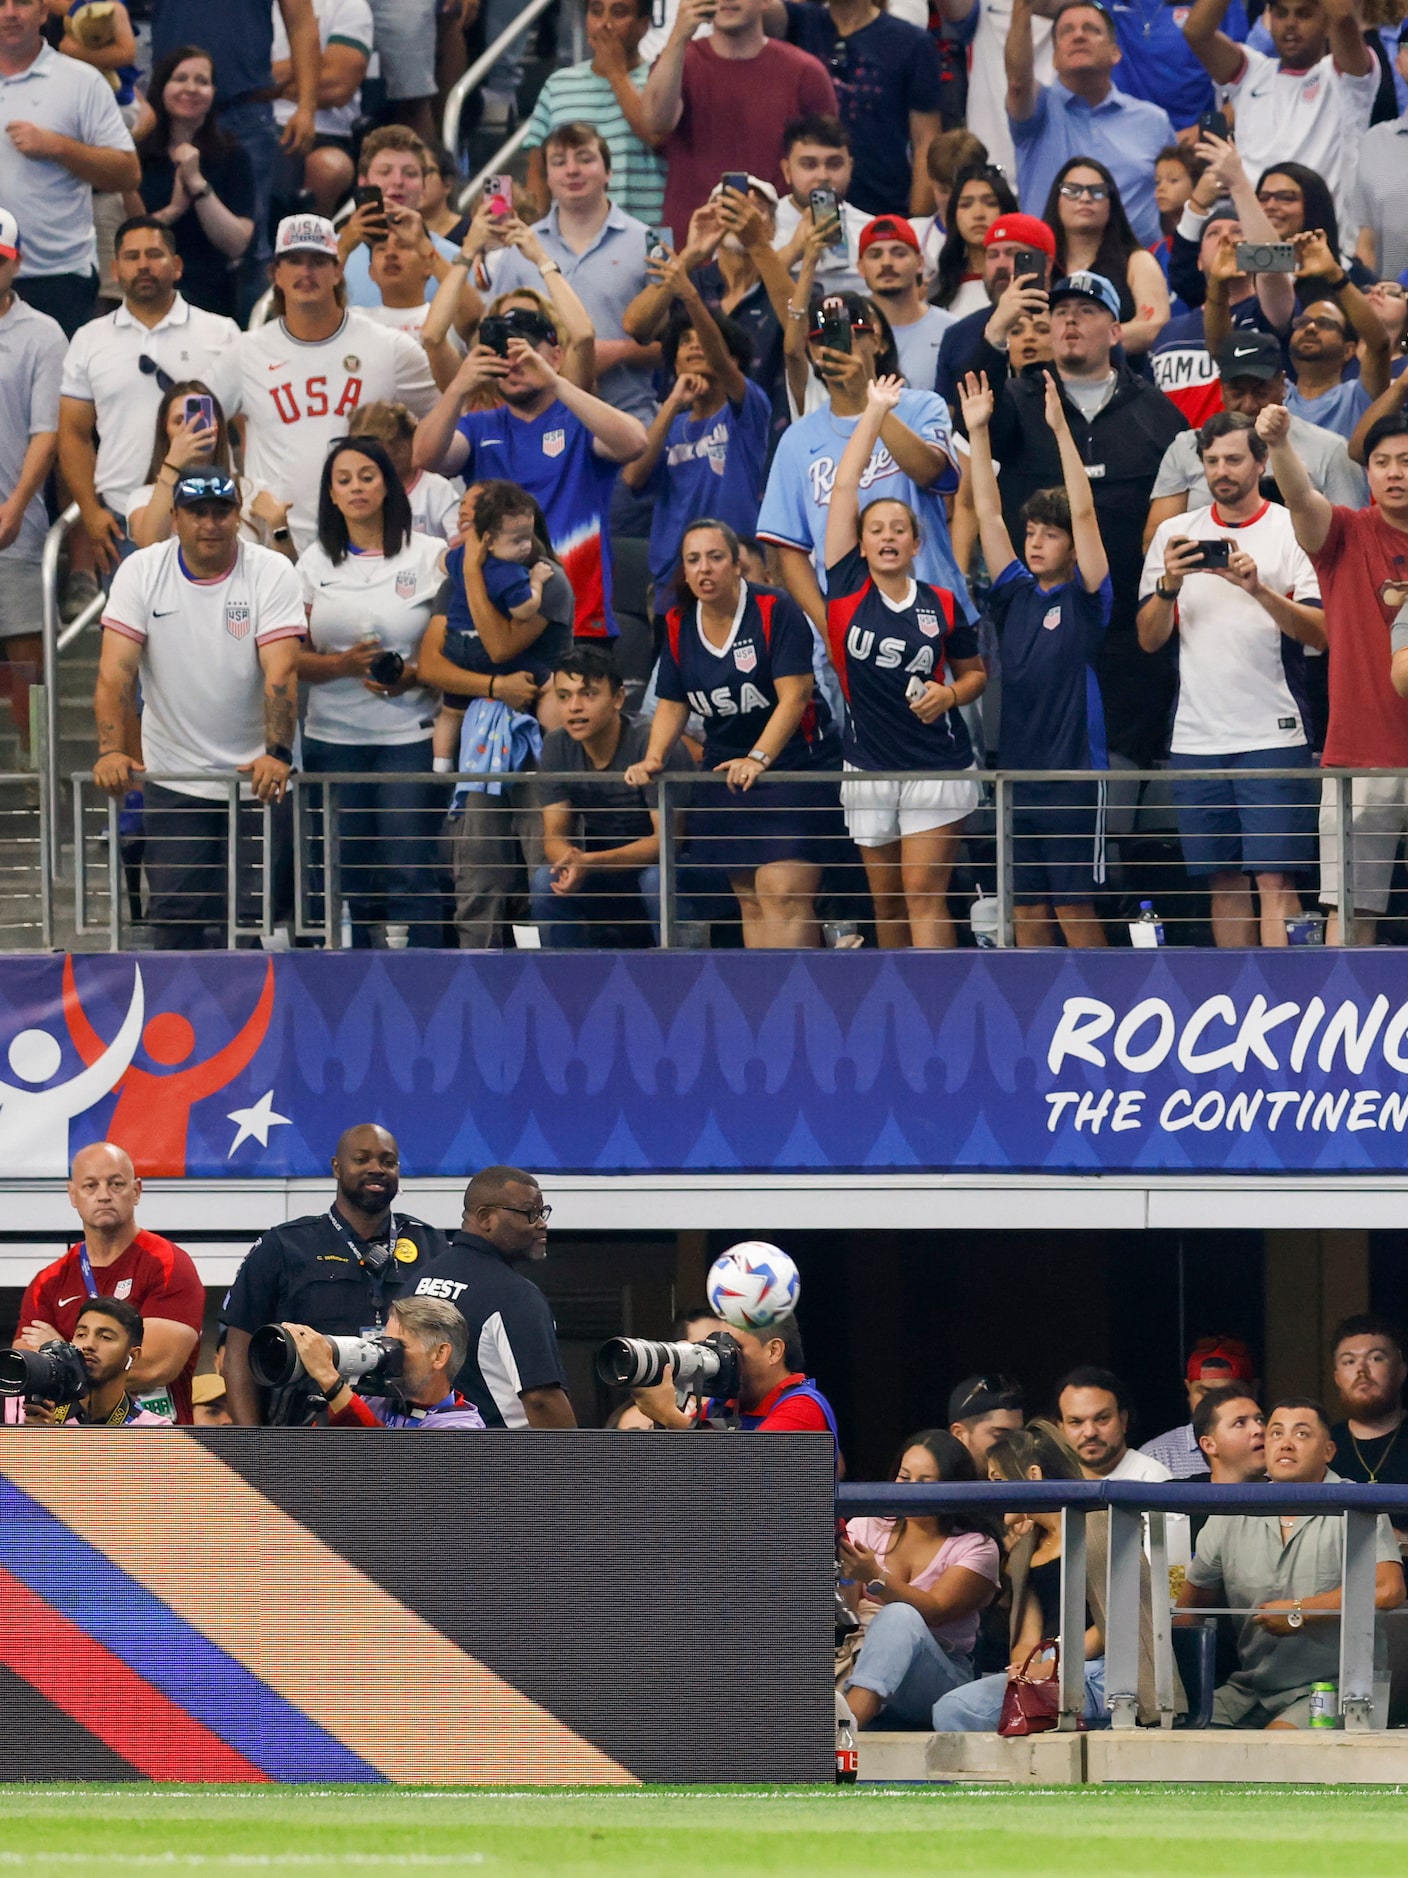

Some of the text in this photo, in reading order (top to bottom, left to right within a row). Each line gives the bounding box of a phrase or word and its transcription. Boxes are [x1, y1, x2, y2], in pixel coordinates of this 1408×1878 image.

[268, 377, 363, 425] USA
[228, 609, 250, 622] USA
[847, 625, 935, 676] USA
[687, 682, 771, 718] USA
[1046, 1092, 1142, 1133] THE
[414, 1277, 469, 1301] BEST
